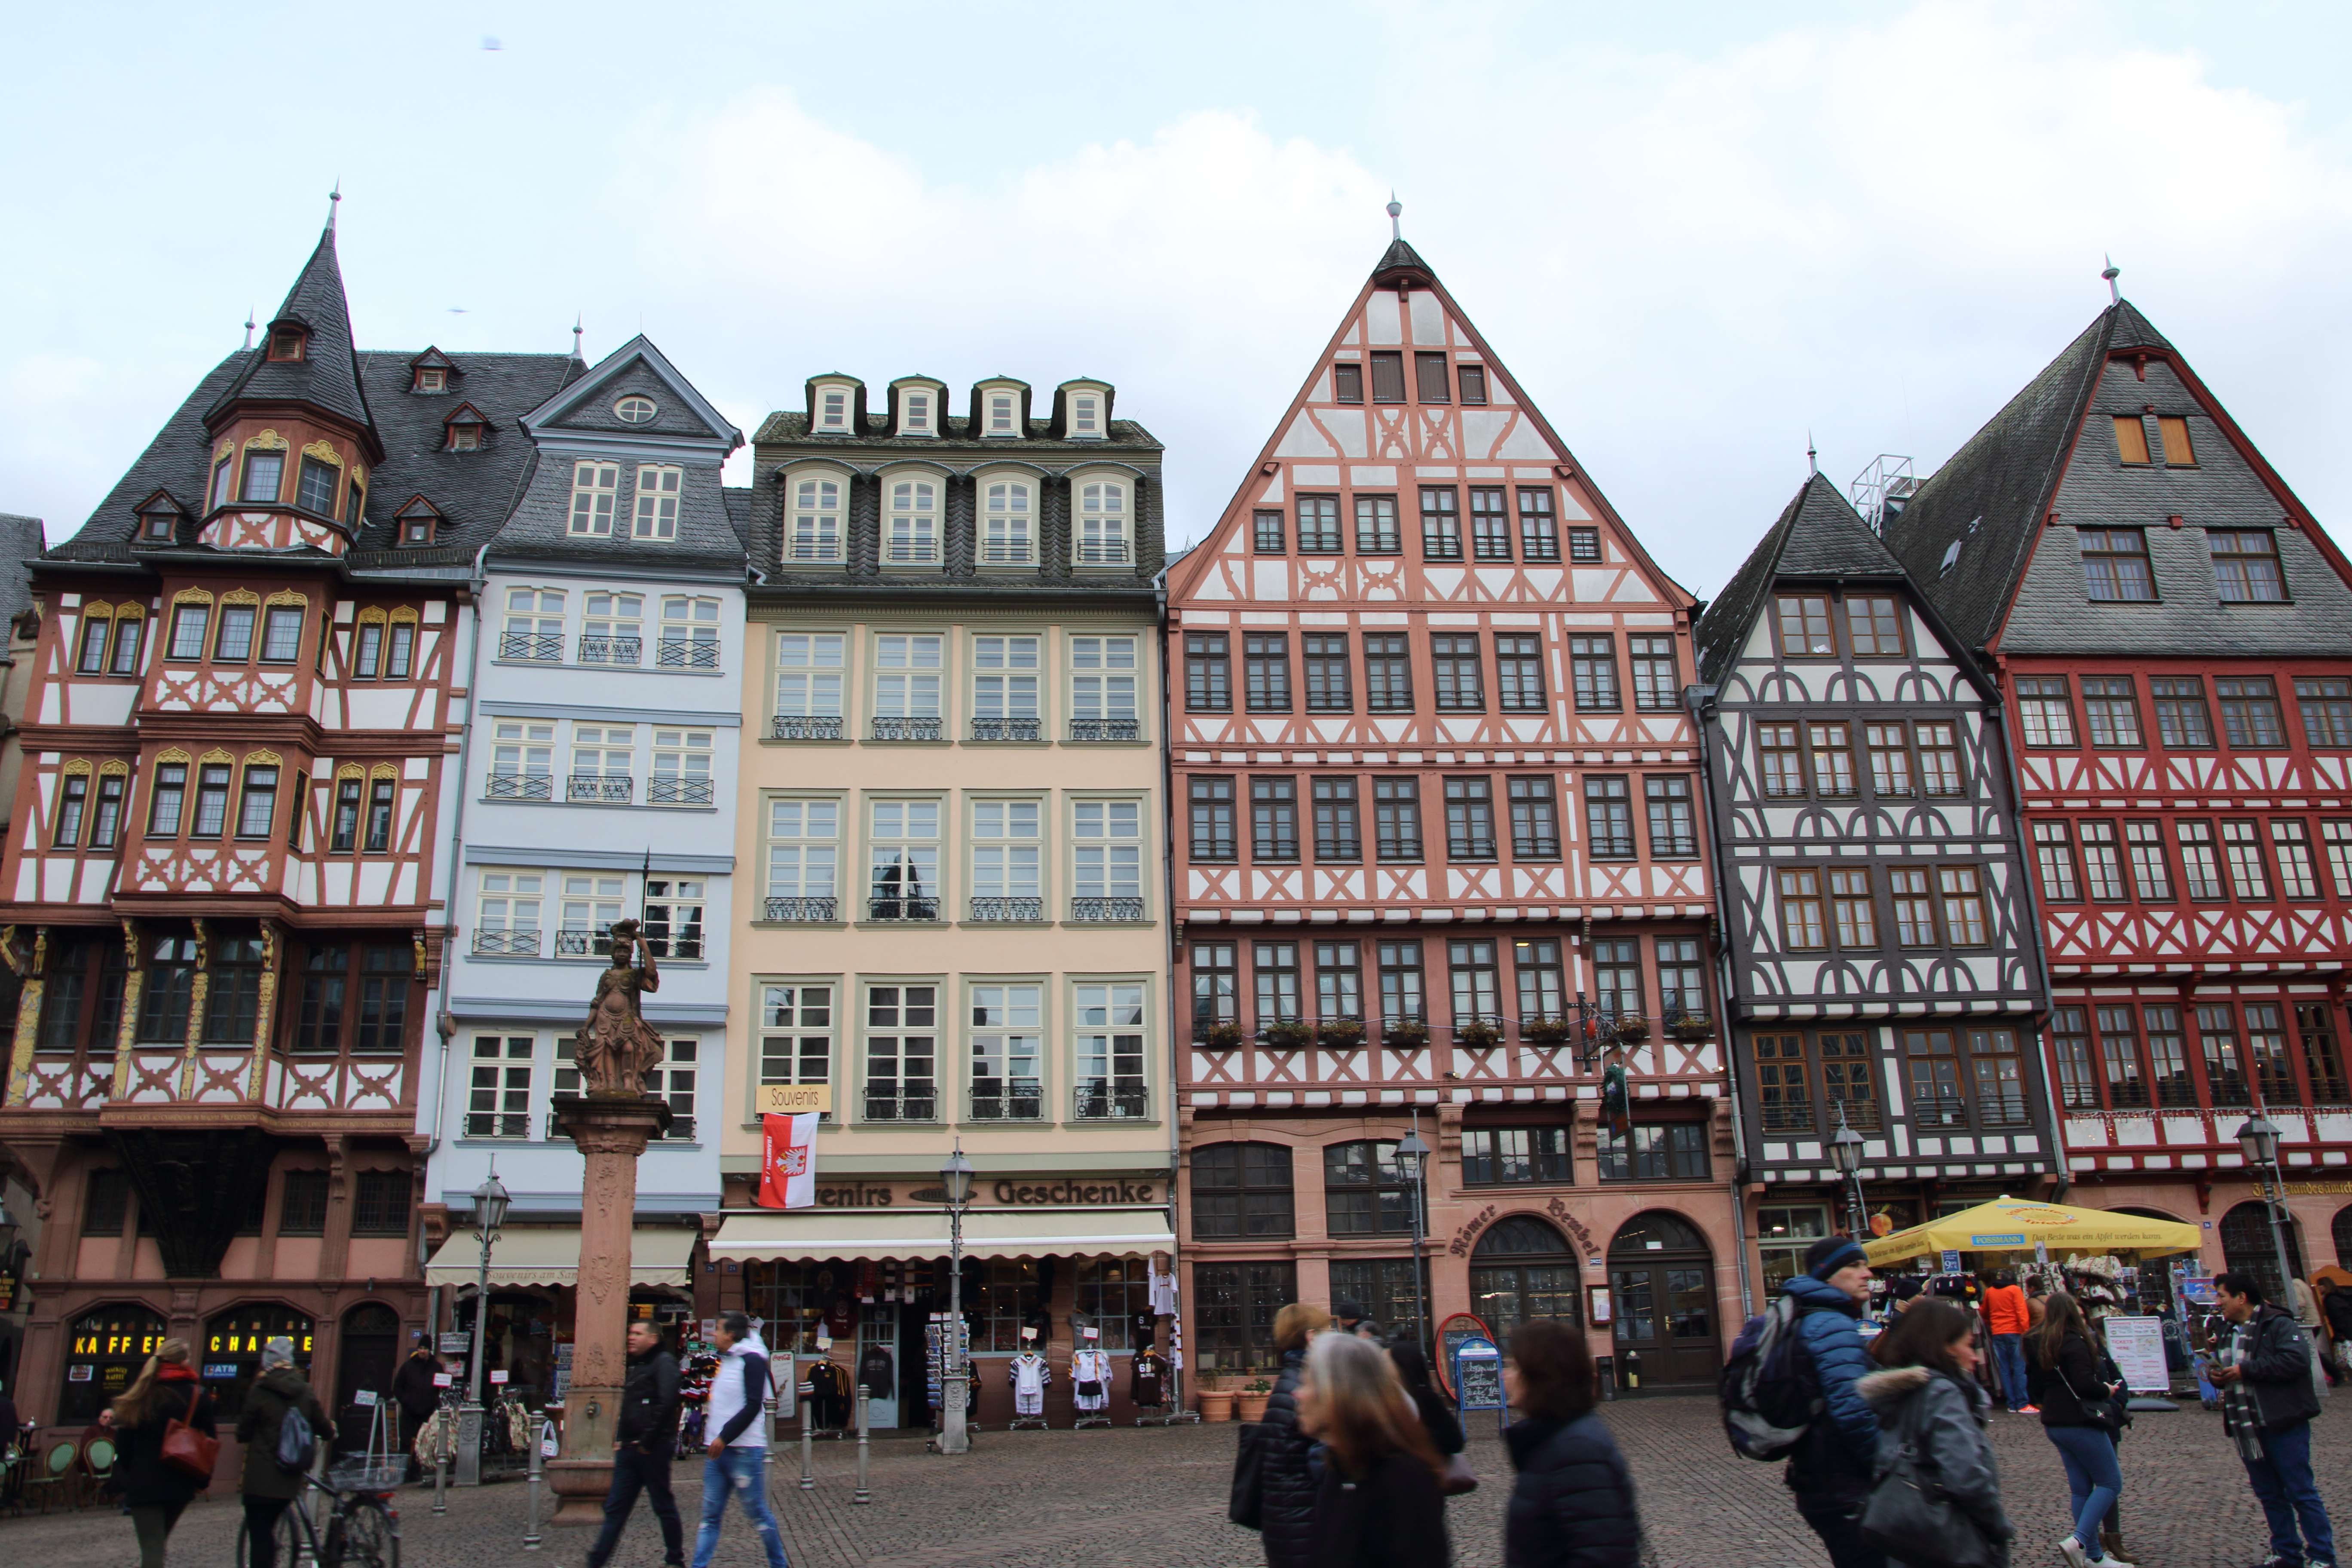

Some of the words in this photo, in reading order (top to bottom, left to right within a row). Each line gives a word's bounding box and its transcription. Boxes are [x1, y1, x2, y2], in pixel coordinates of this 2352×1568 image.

[772, 1088, 818, 1106] Souvenirs
[994, 1180, 1153, 1204] Geschenke
[1450, 1204, 1496, 1258] Römer
[1547, 1197, 1601, 1256] Bembel
[1976, 1235, 2021, 1244] POSSMANN
[2095, 1232, 2113, 1242] Apfel
[488, 1271, 537, 1279] Souvenirs
